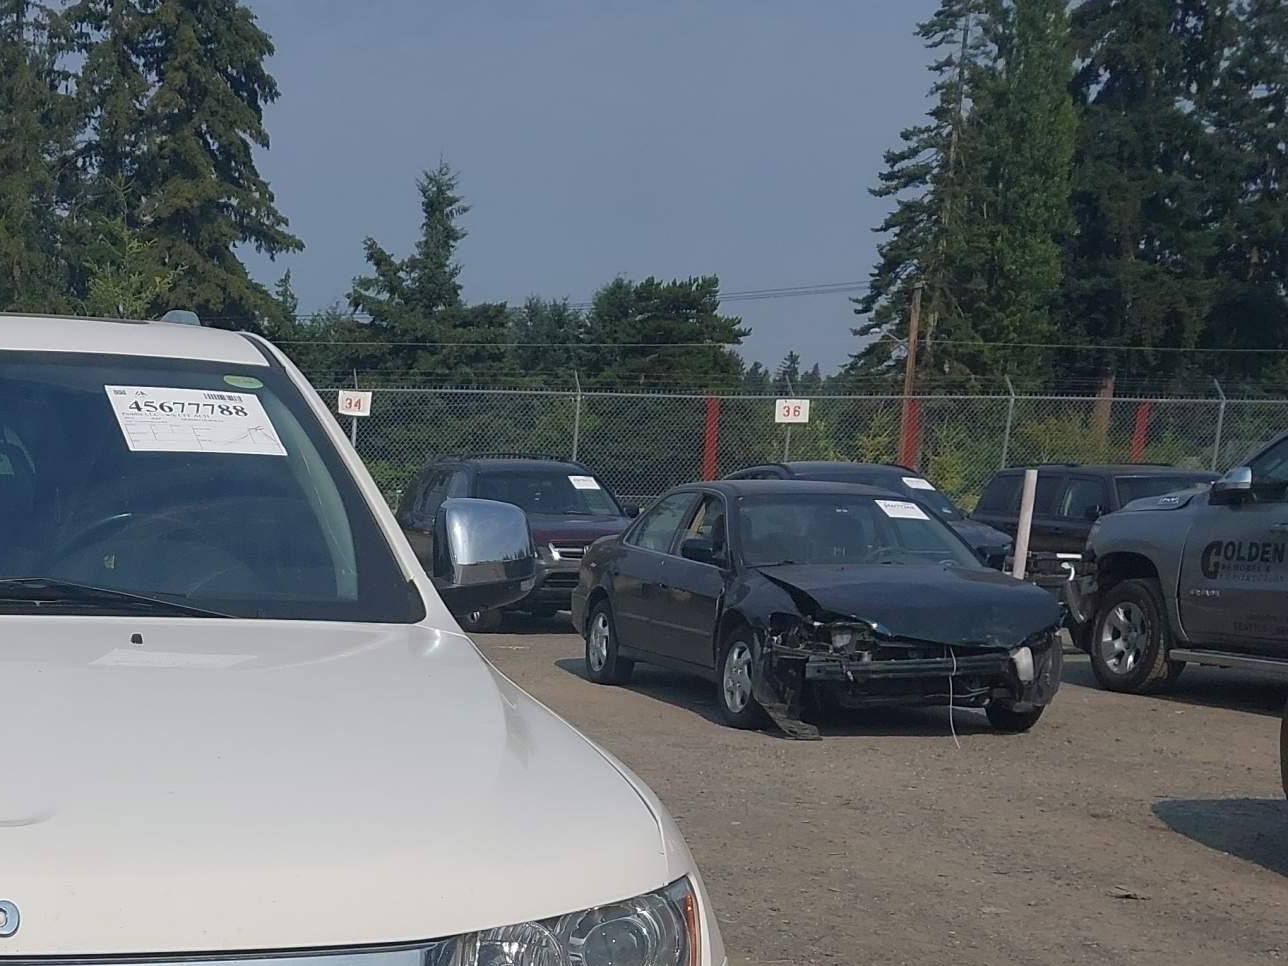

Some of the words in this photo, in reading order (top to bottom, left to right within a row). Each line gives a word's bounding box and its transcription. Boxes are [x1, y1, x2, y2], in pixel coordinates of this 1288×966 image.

[129, 400, 249, 418] 45677788
[344, 397, 362, 411] 34
[782, 404, 801, 418] 36
[1201, 540, 1286, 579] GOLDEN
